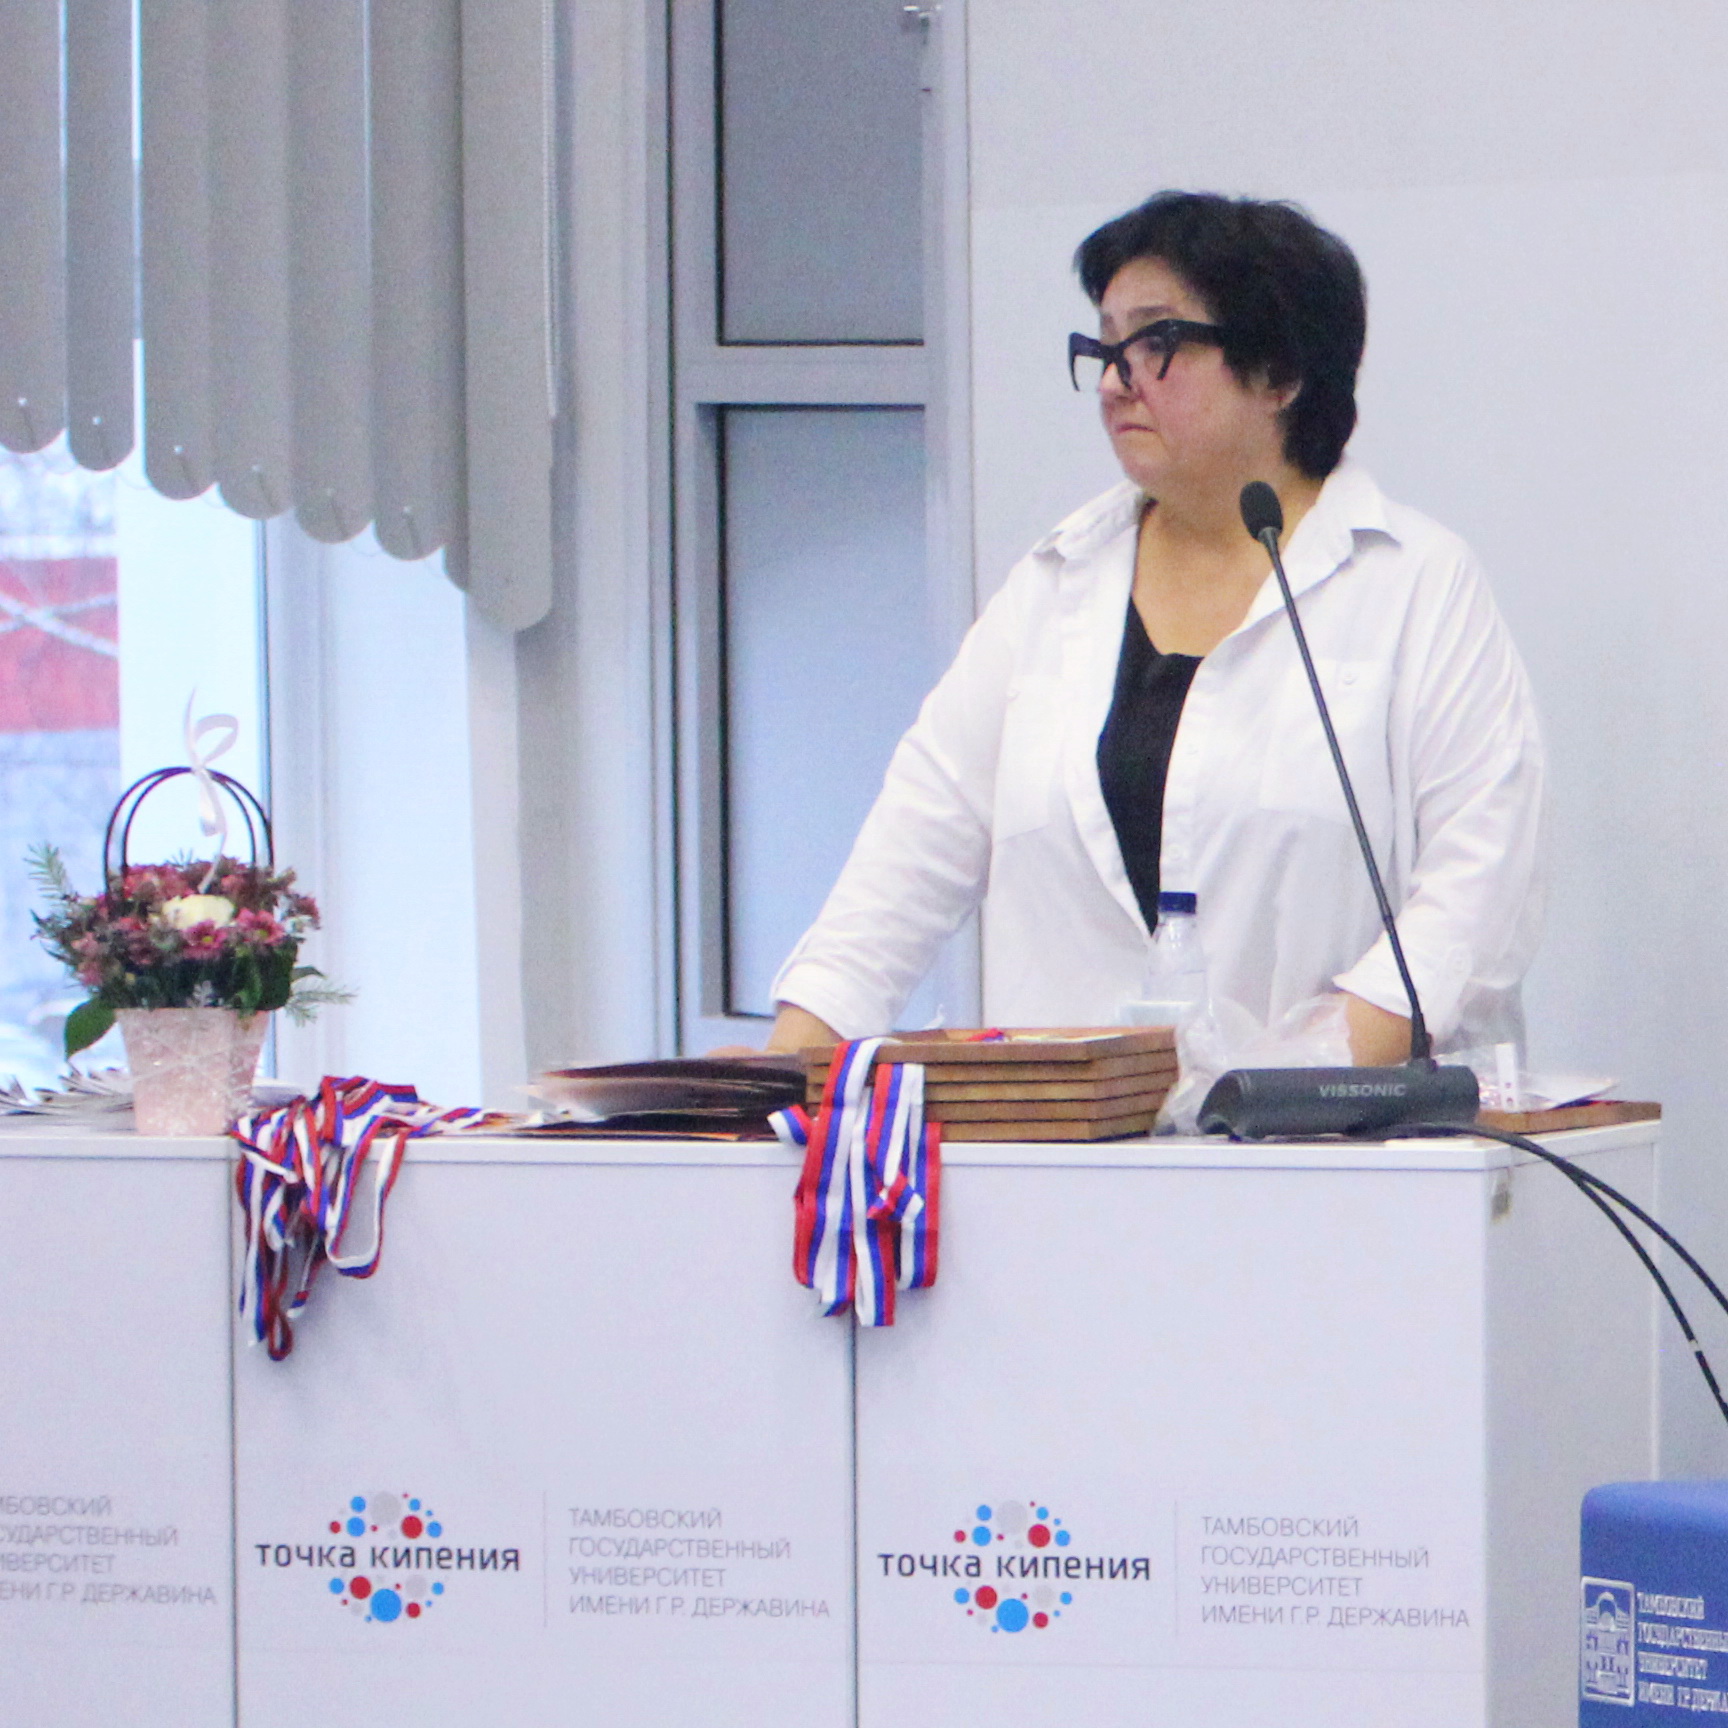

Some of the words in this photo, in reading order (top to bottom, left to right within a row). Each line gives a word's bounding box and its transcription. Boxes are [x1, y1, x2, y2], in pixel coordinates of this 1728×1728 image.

[1318, 1083, 1407, 1098] VISSONIC
[0, 1495, 112, 1516] БОВСКИЙ
[568, 1507, 722, 1529] ТАМБОВСКИЙ
[1201, 1515, 1359, 1537] ТАМБОВСКИЙ
[255, 1544, 356, 1568] точка
[370, 1546, 520, 1572] кипения
[568, 1537, 791, 1559] ГОСУДАРСТВЕННЫЙ
[1201, 1545, 1429, 1569] ГОСУДАРСТВЕННЫЙ
[0, 1553, 116, 1574] ВЕРСИТЕТ
[877, 1553, 981, 1578] точка
[997, 1555, 1151, 1580] кипения
[568, 1566, 726, 1587] УНИВЕРСИТЕТ
[1200, 1576, 1363, 1597] УНИВЕРСИТЕТ
[80, 1582, 218, 1605] ДЕРЖАВИНА
[569, 1595, 649, 1615] ИМЕНИ
[691, 1597, 830, 1619] ДЕРЖАВИНА
[1201, 1605, 1283, 1624] ИМЕНИ
[1327, 1606, 1470, 1628] ДЕРЖАВИНА
